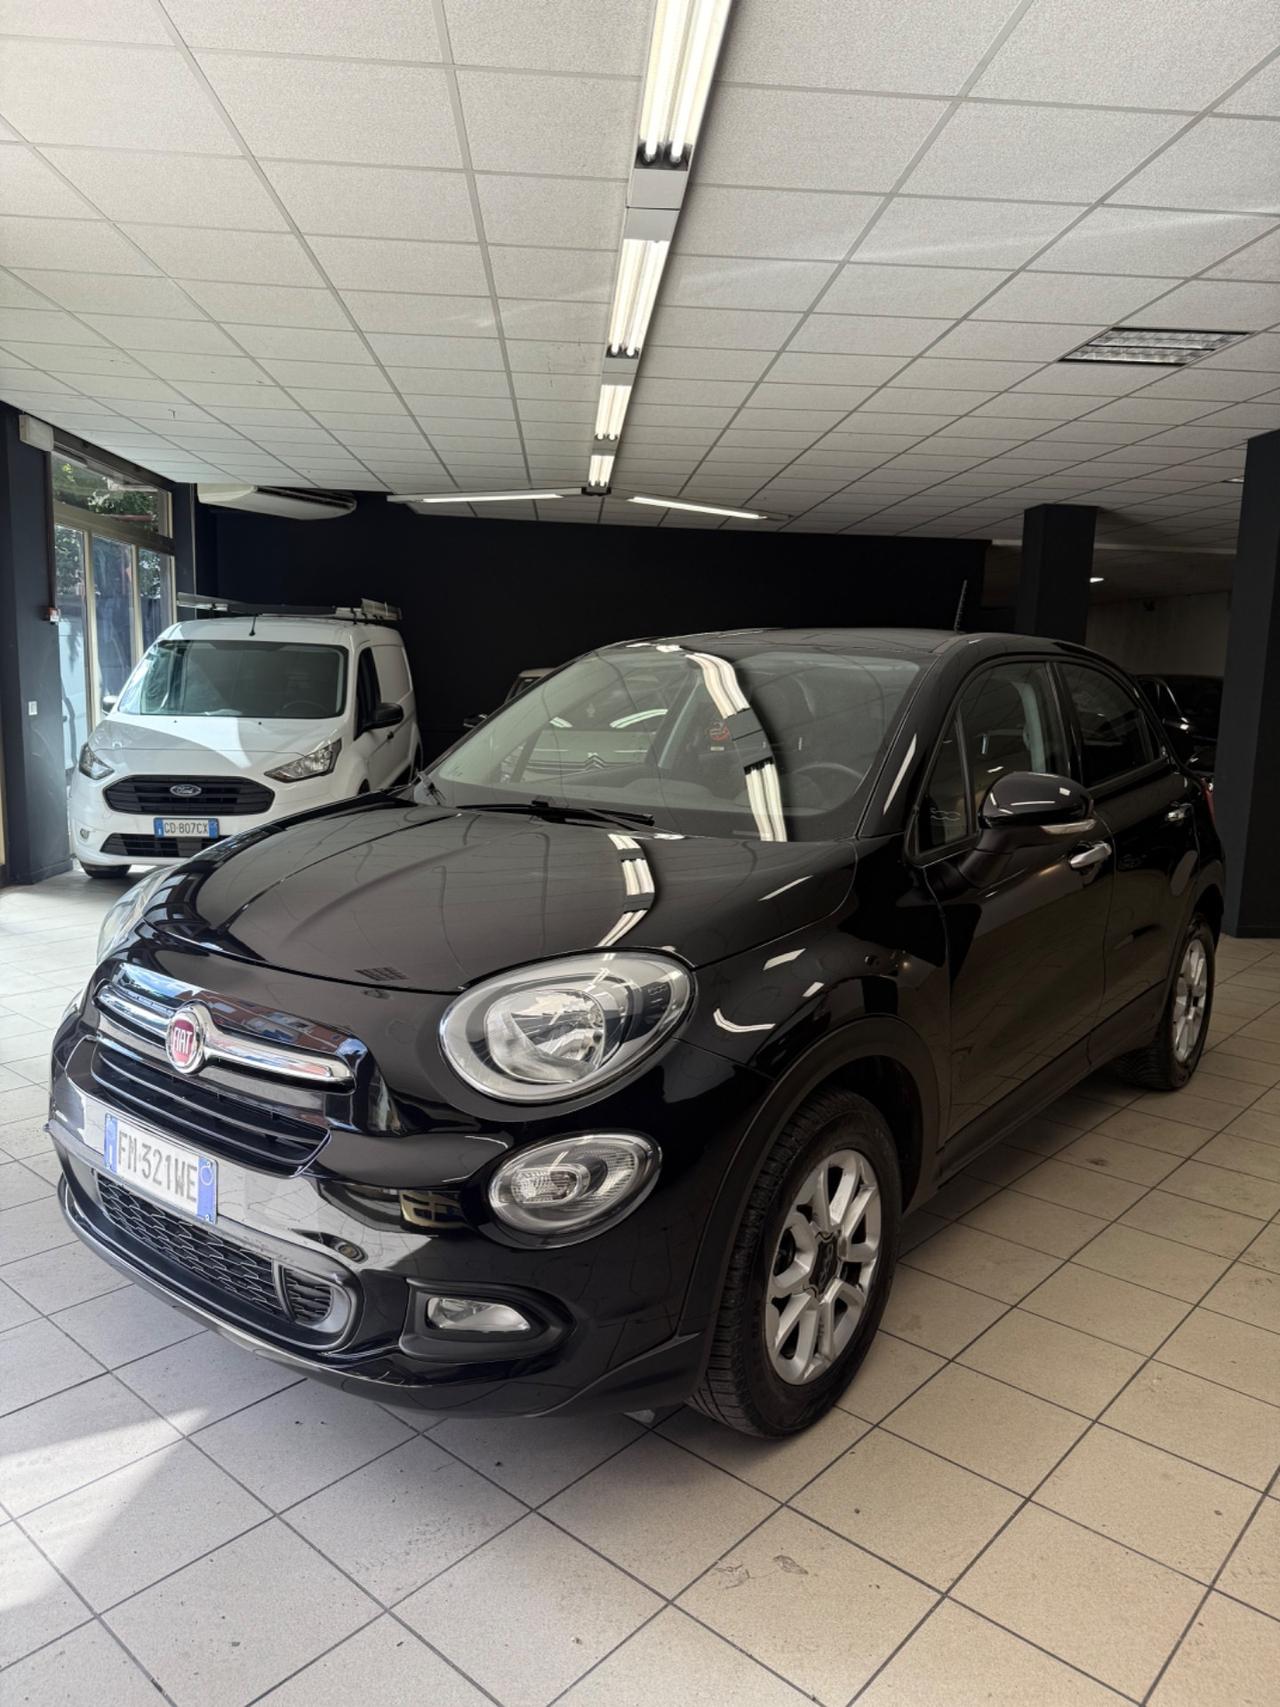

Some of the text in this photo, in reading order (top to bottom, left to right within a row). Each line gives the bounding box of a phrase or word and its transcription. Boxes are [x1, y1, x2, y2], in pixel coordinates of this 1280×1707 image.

[179, 822, 208, 834] 807CX
[172, 1026, 193, 1055] FIAT
[118, 1130, 198, 1202] FM 321WE
